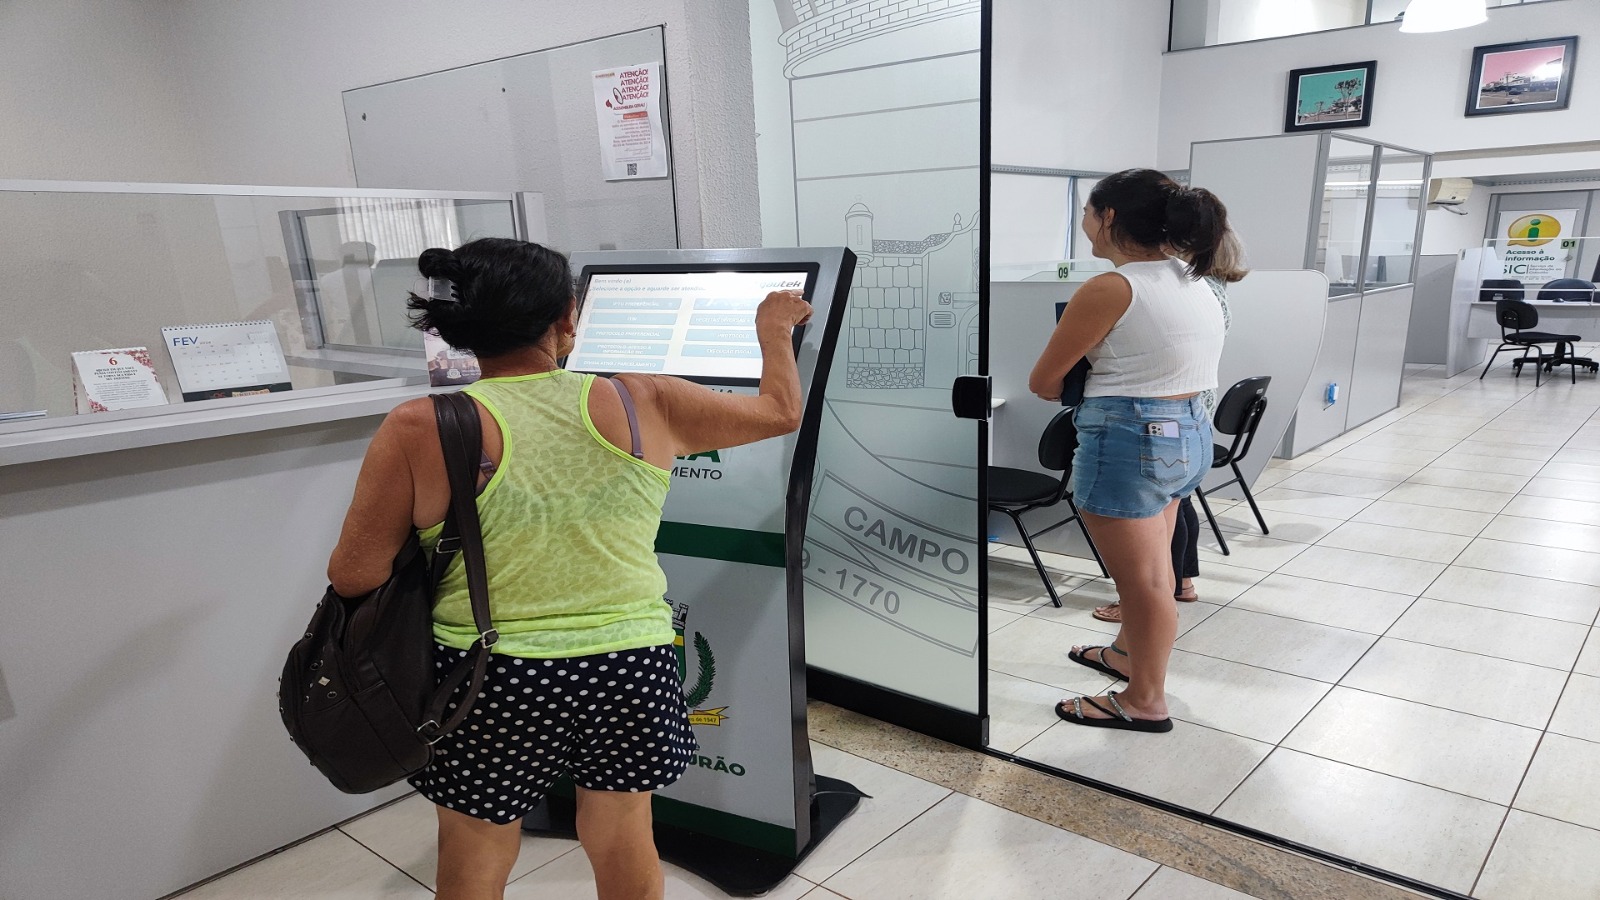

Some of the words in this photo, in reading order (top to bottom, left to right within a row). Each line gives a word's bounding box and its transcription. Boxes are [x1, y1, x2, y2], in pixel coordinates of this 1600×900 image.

[620, 68, 648, 79] ATENÇÃO!
[620, 76, 648, 86] ATENÇÃO!
[622, 84, 649, 94] ATENÇÃO!
[622, 92, 649, 100] ATENÇÃO!
[1058, 266, 1068, 278] 09
[173, 336, 198, 346] FEV
[108, 357, 118, 366] 6
[670, 466, 722, 480] MENTO
[844, 506, 969, 575] CAMPO
[802, 548, 811, 570] 9
[836, 568, 900, 614] 1770
[688, 754, 746, 776] URÃO
